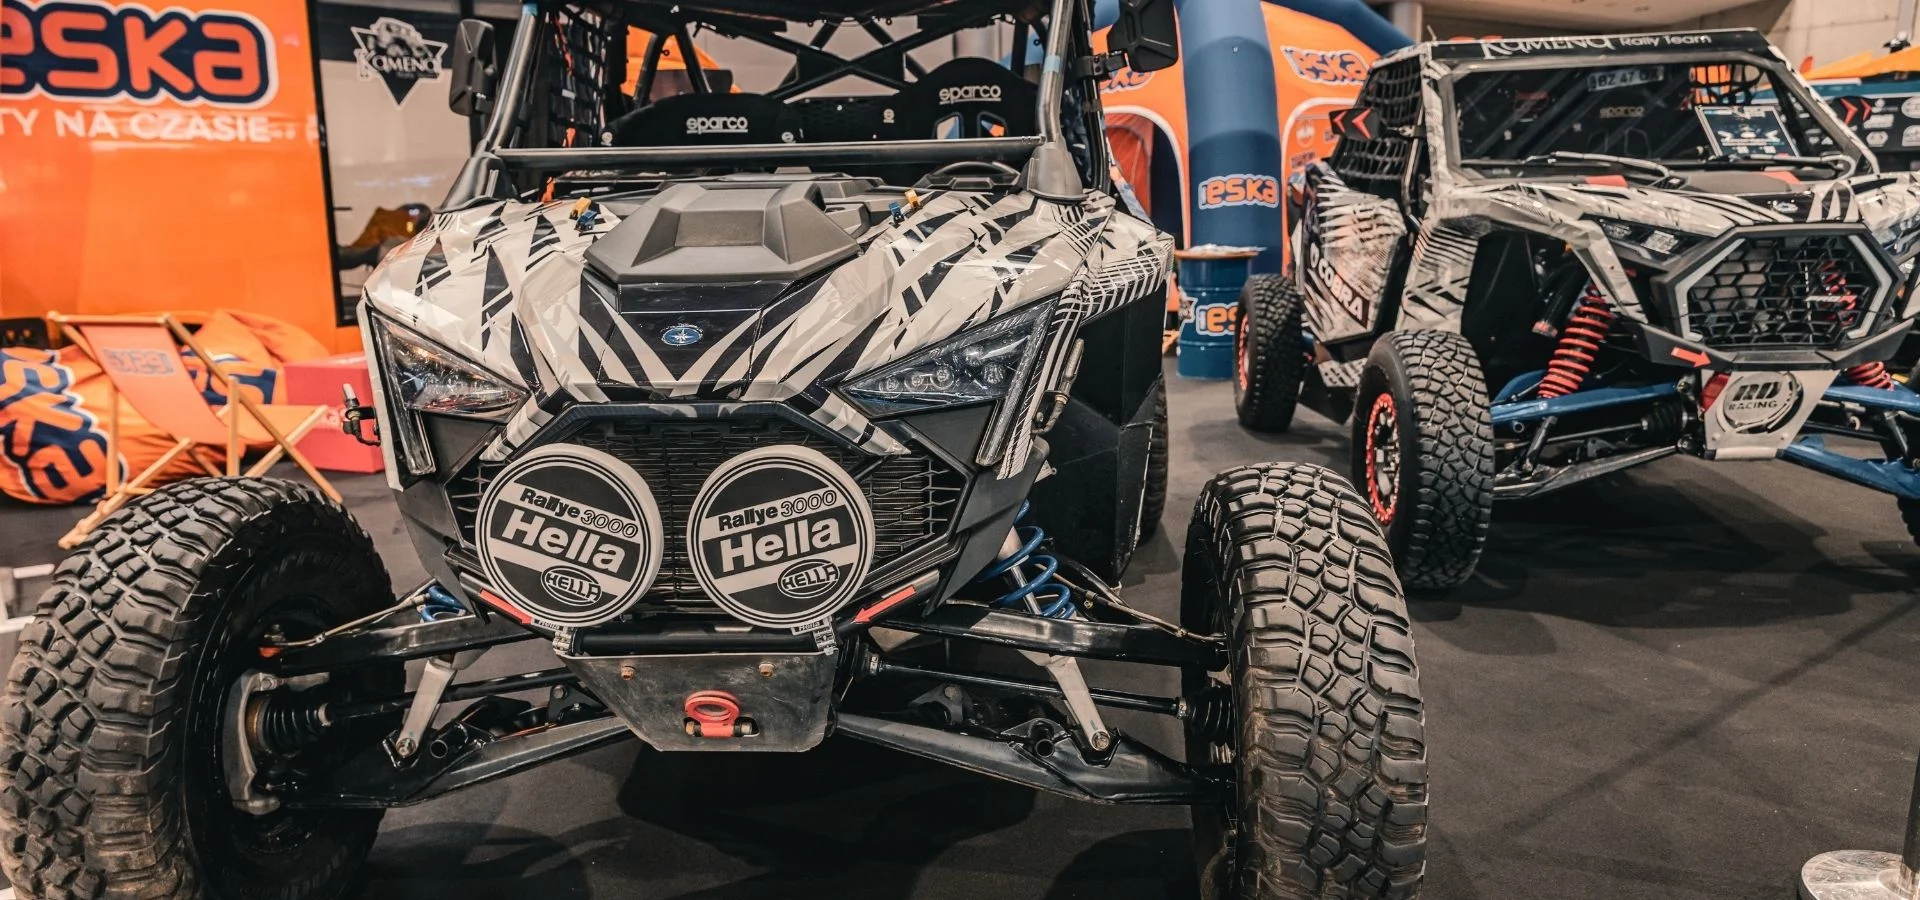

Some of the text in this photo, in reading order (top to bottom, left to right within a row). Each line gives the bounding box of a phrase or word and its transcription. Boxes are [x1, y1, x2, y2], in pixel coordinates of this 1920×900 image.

[1619, 36, 1659, 47] Rally
[1664, 34, 1712, 46] Team
[939, 85, 1002, 104] sparco
[54, 109, 119, 138] NA
[130, 112, 273, 143] CZASIE
[686, 116, 749, 134] sparco
[1318, 258, 1363, 320] COBRA
[1728, 400, 1778, 411] RACING
[519, 488, 638, 538] Rallye 3000
[718, 489, 837, 531] Rallye 3000
[501, 508, 626, 574] Hella
[720, 517, 841, 572] Hella
[546, 572, 602, 602] HELLA
[781, 562, 839, 590] HELLA
